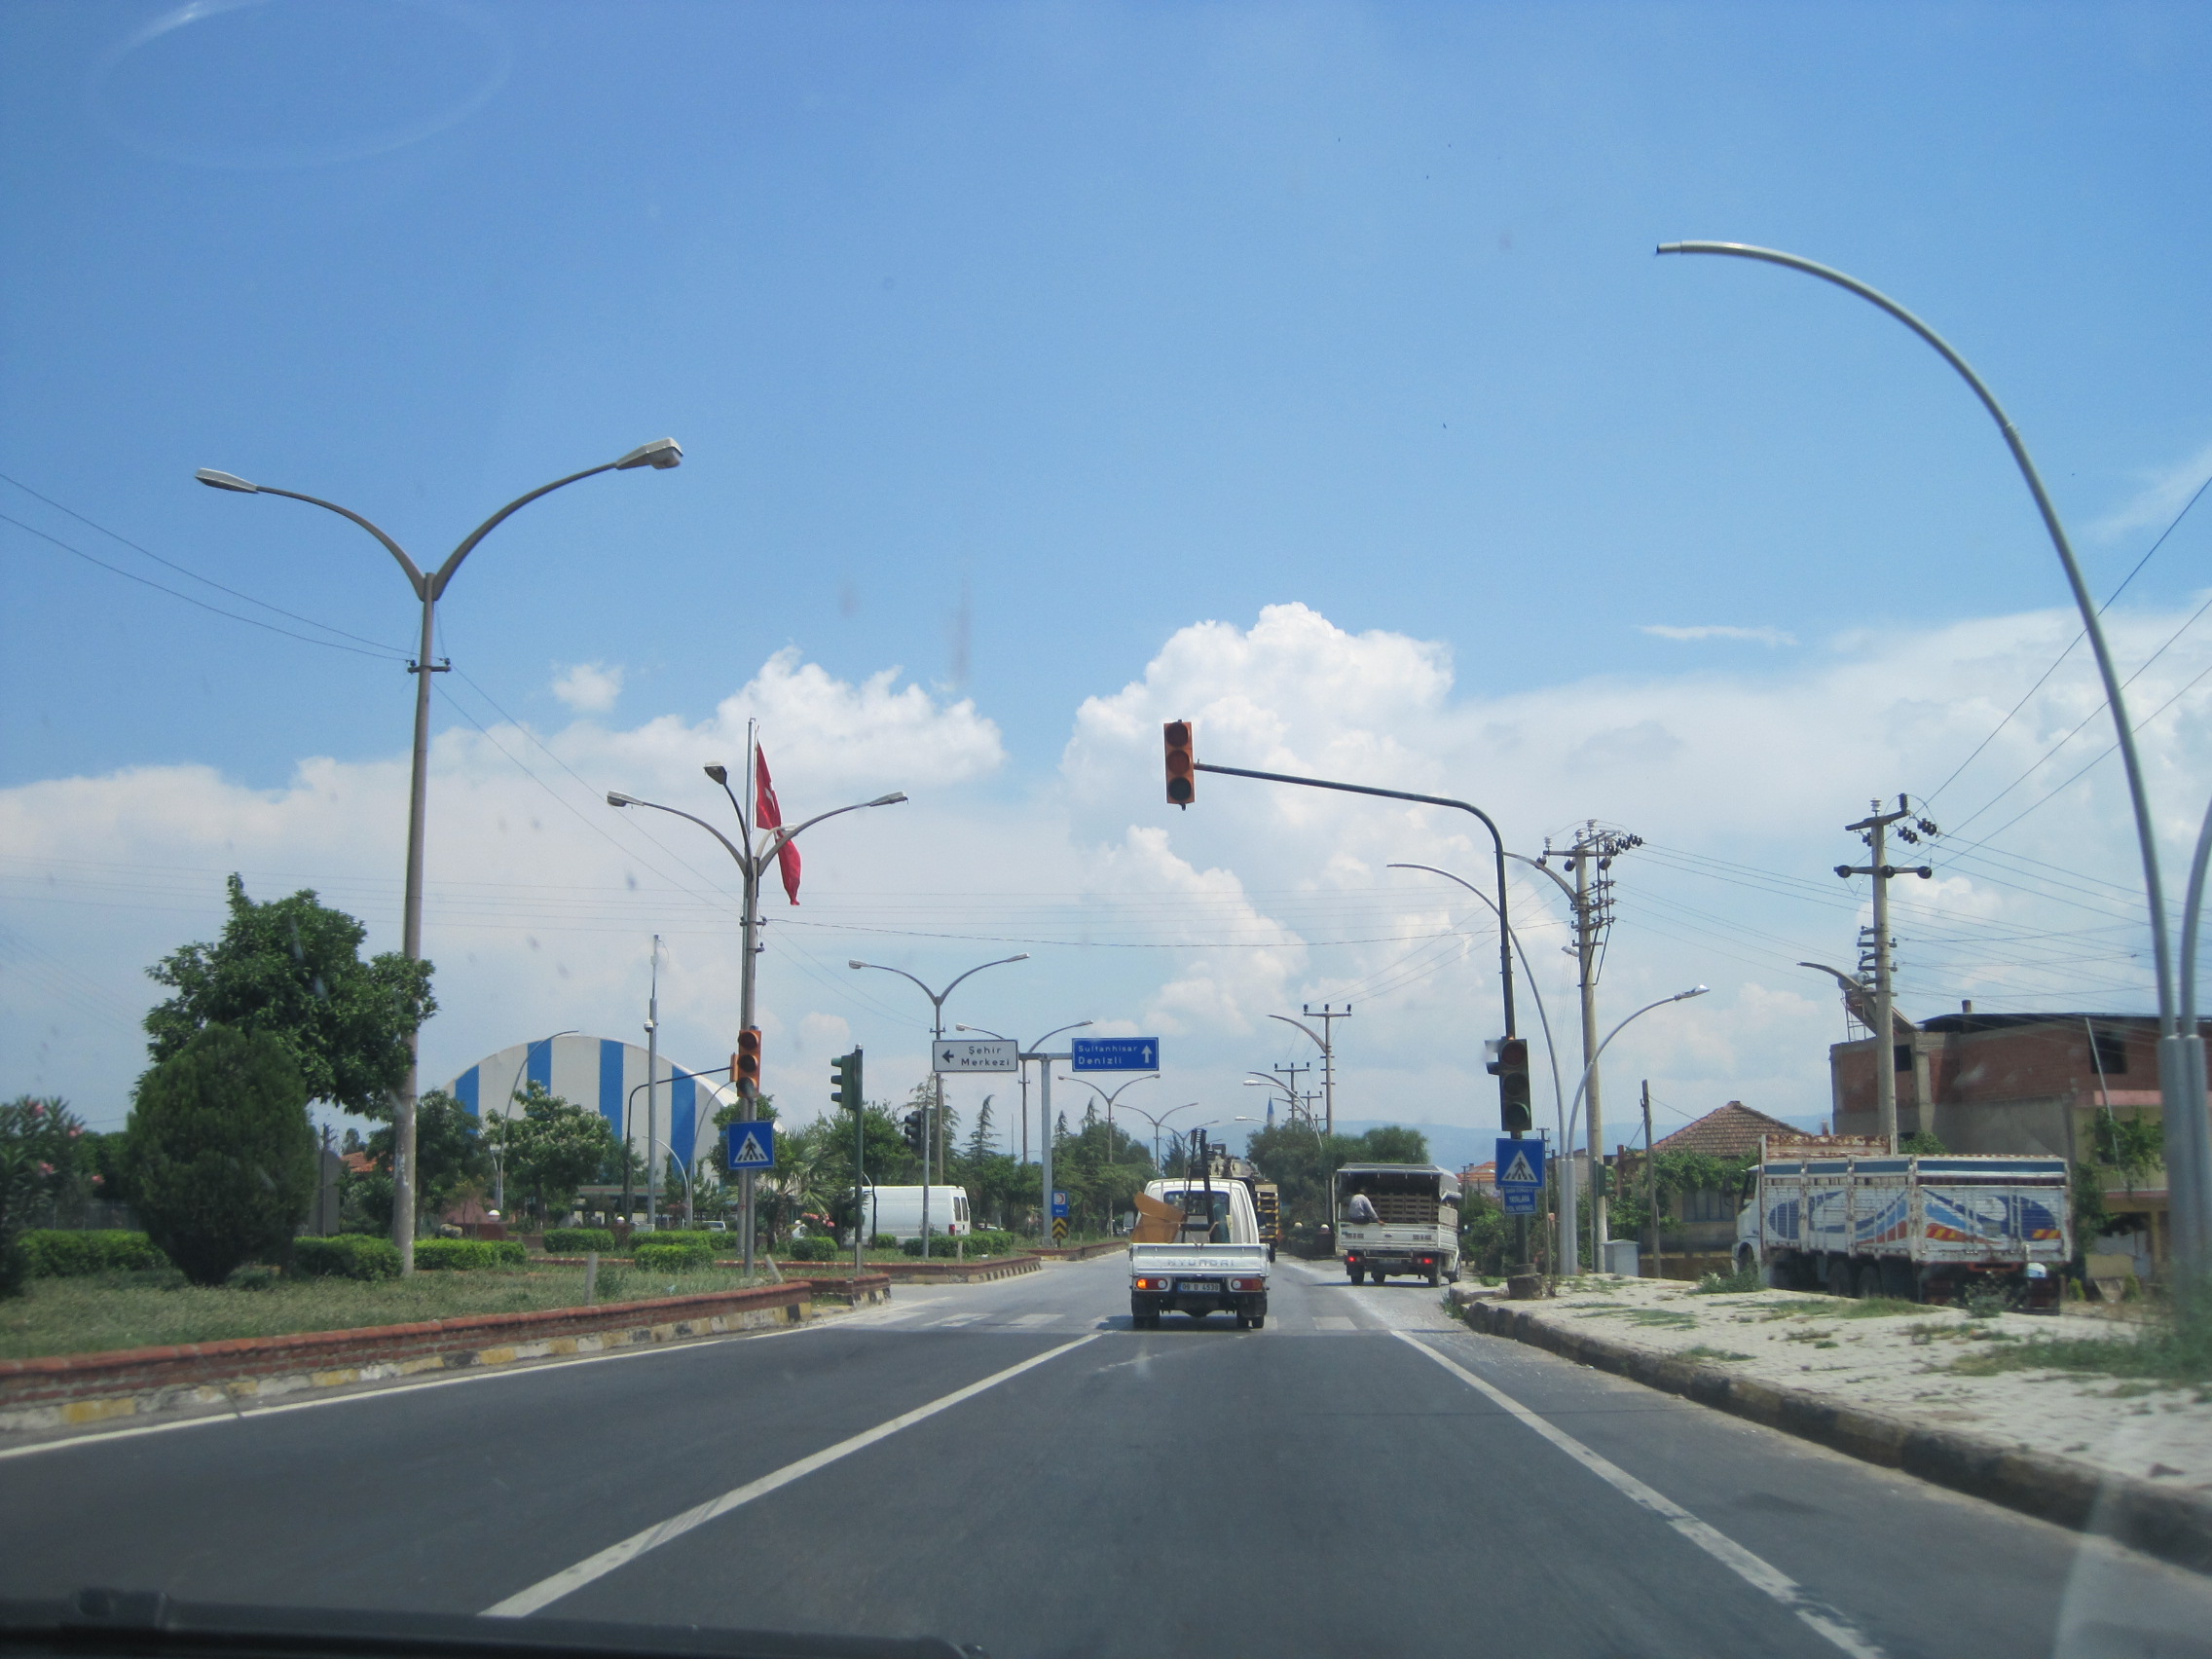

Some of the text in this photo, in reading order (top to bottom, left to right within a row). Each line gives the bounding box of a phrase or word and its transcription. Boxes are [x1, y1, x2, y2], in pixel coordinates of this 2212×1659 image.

[968, 1046, 1002, 1055] Şehir
[961, 1057, 1011, 1066] Merkezi
[1078, 1056, 1123, 1065] Denizli
